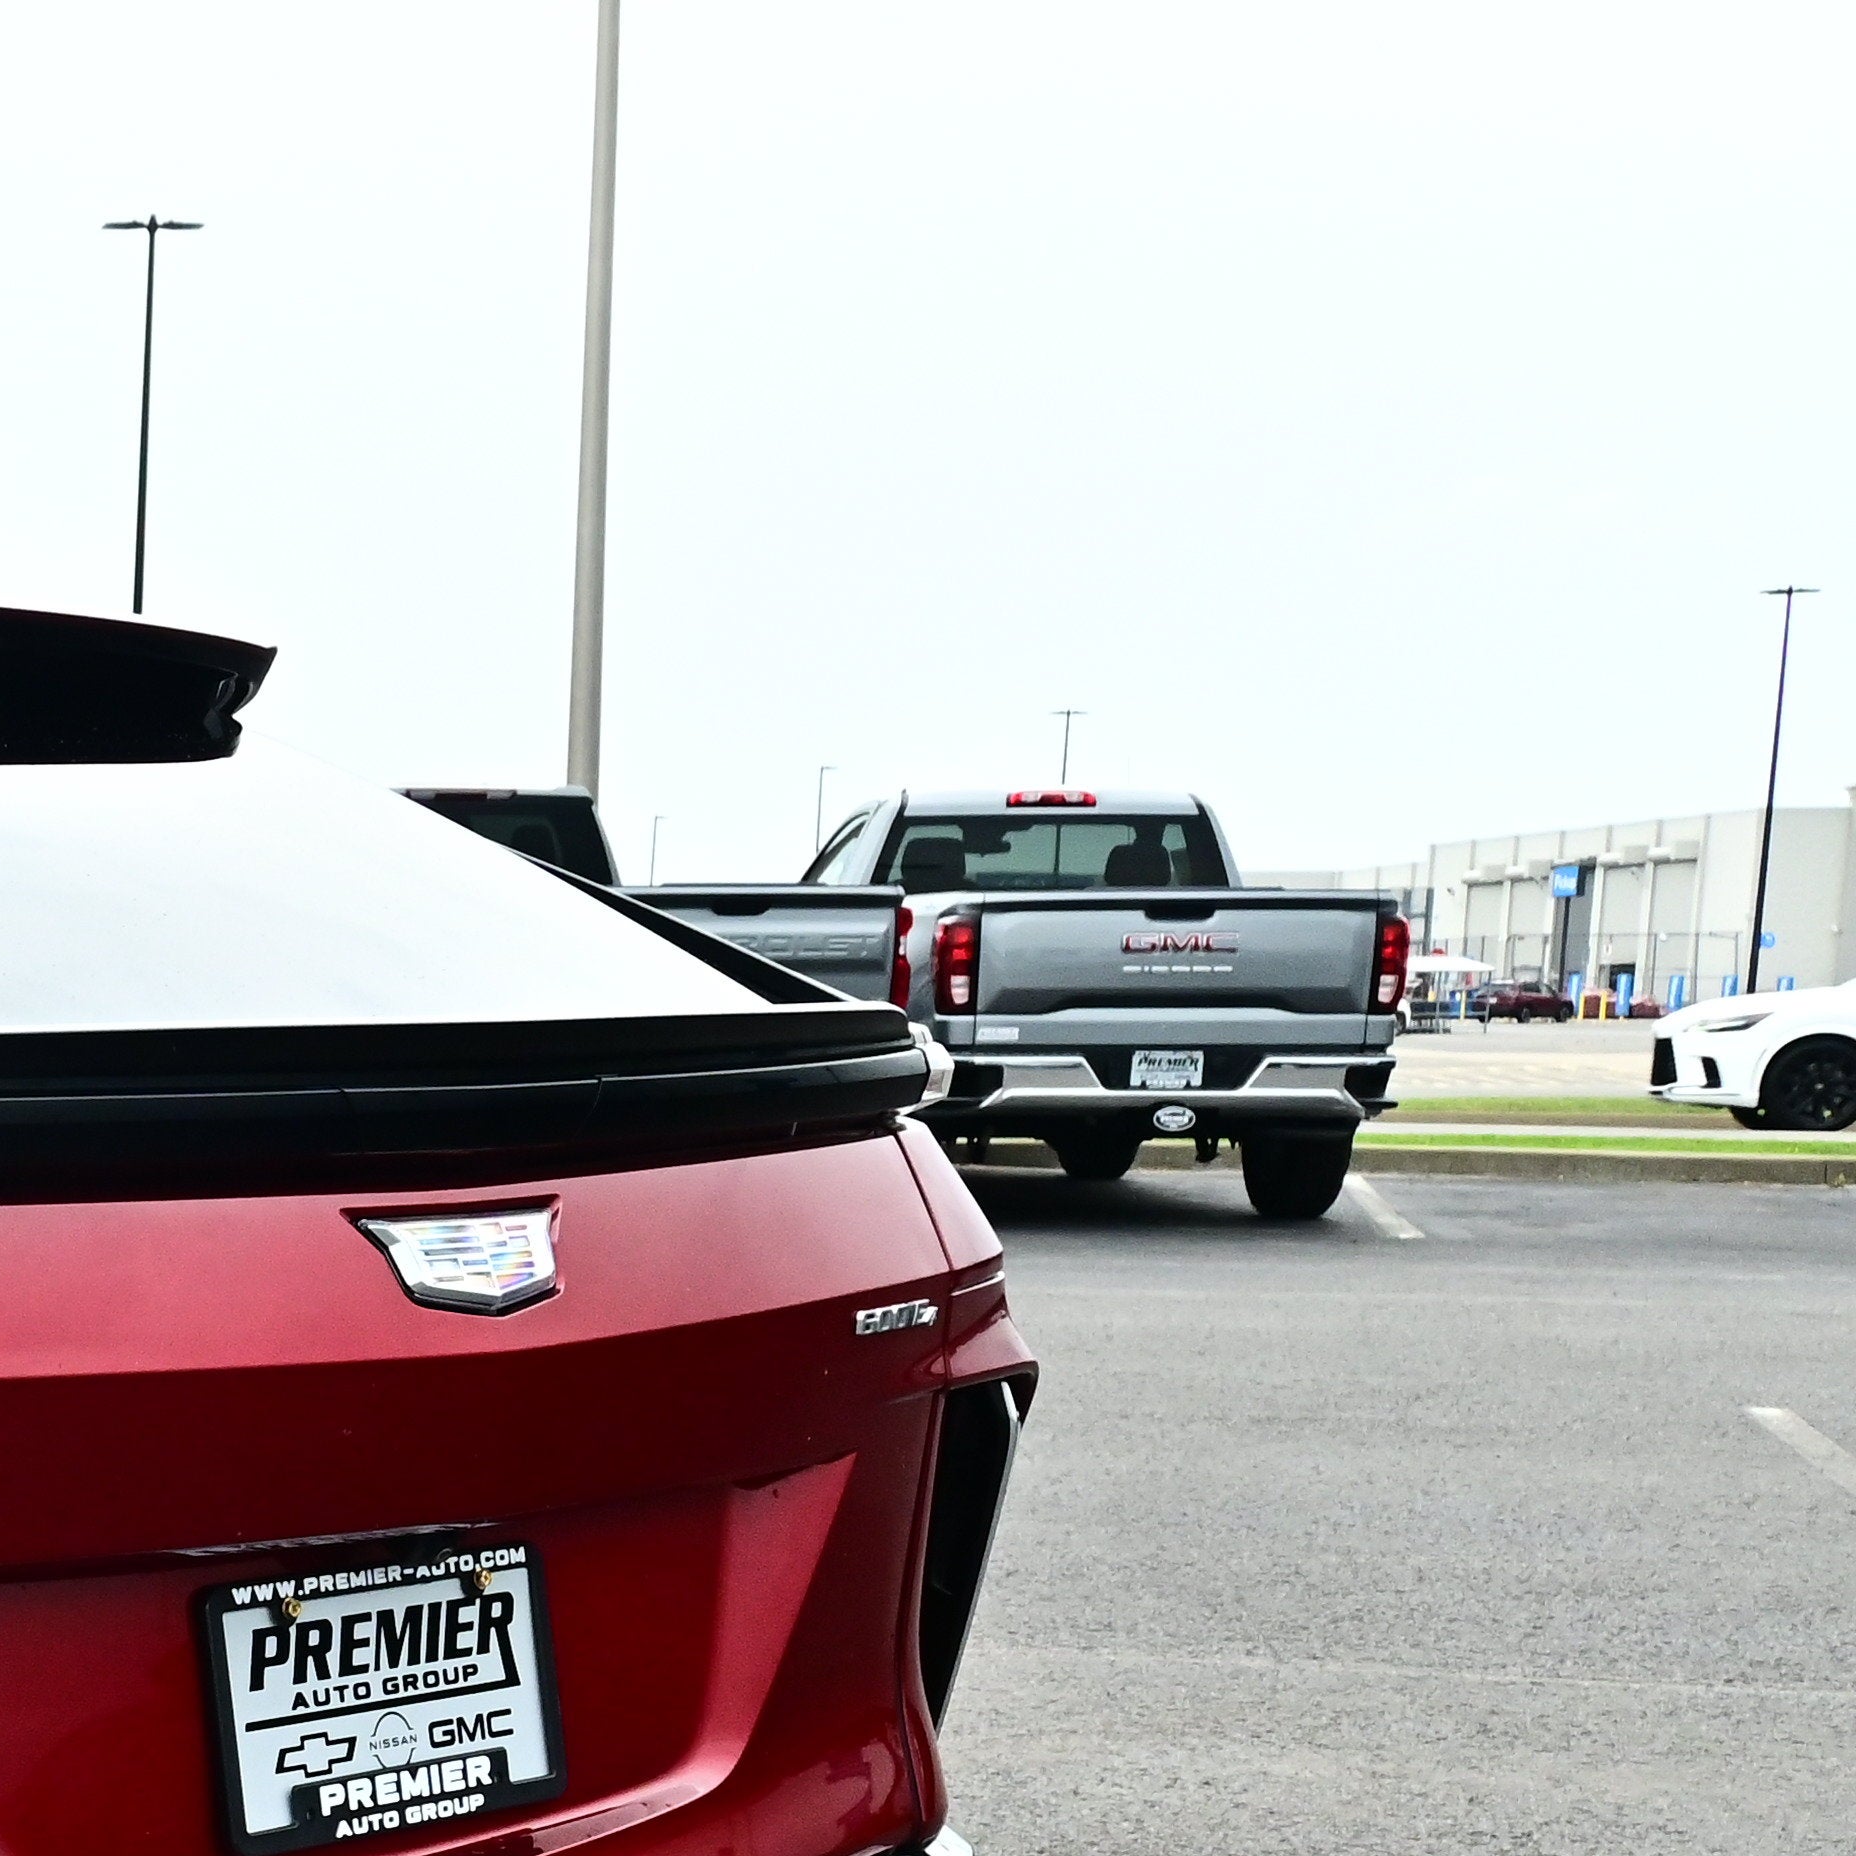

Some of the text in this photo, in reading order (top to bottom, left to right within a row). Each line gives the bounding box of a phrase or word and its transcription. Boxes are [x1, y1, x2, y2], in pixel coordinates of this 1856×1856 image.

[1121, 931, 1239, 954] GMC
[231, 1546, 527, 1605] WWW.PREMIER-AUTO.COM
[249, 1591, 521, 1692] PREMIER
[291, 1663, 479, 1711] AUTO GROUP
[369, 1708, 514, 1751] NISSAN GMC
[319, 1754, 493, 1817] PREMIER
[335, 1793, 485, 1839] AUTO GROUP
